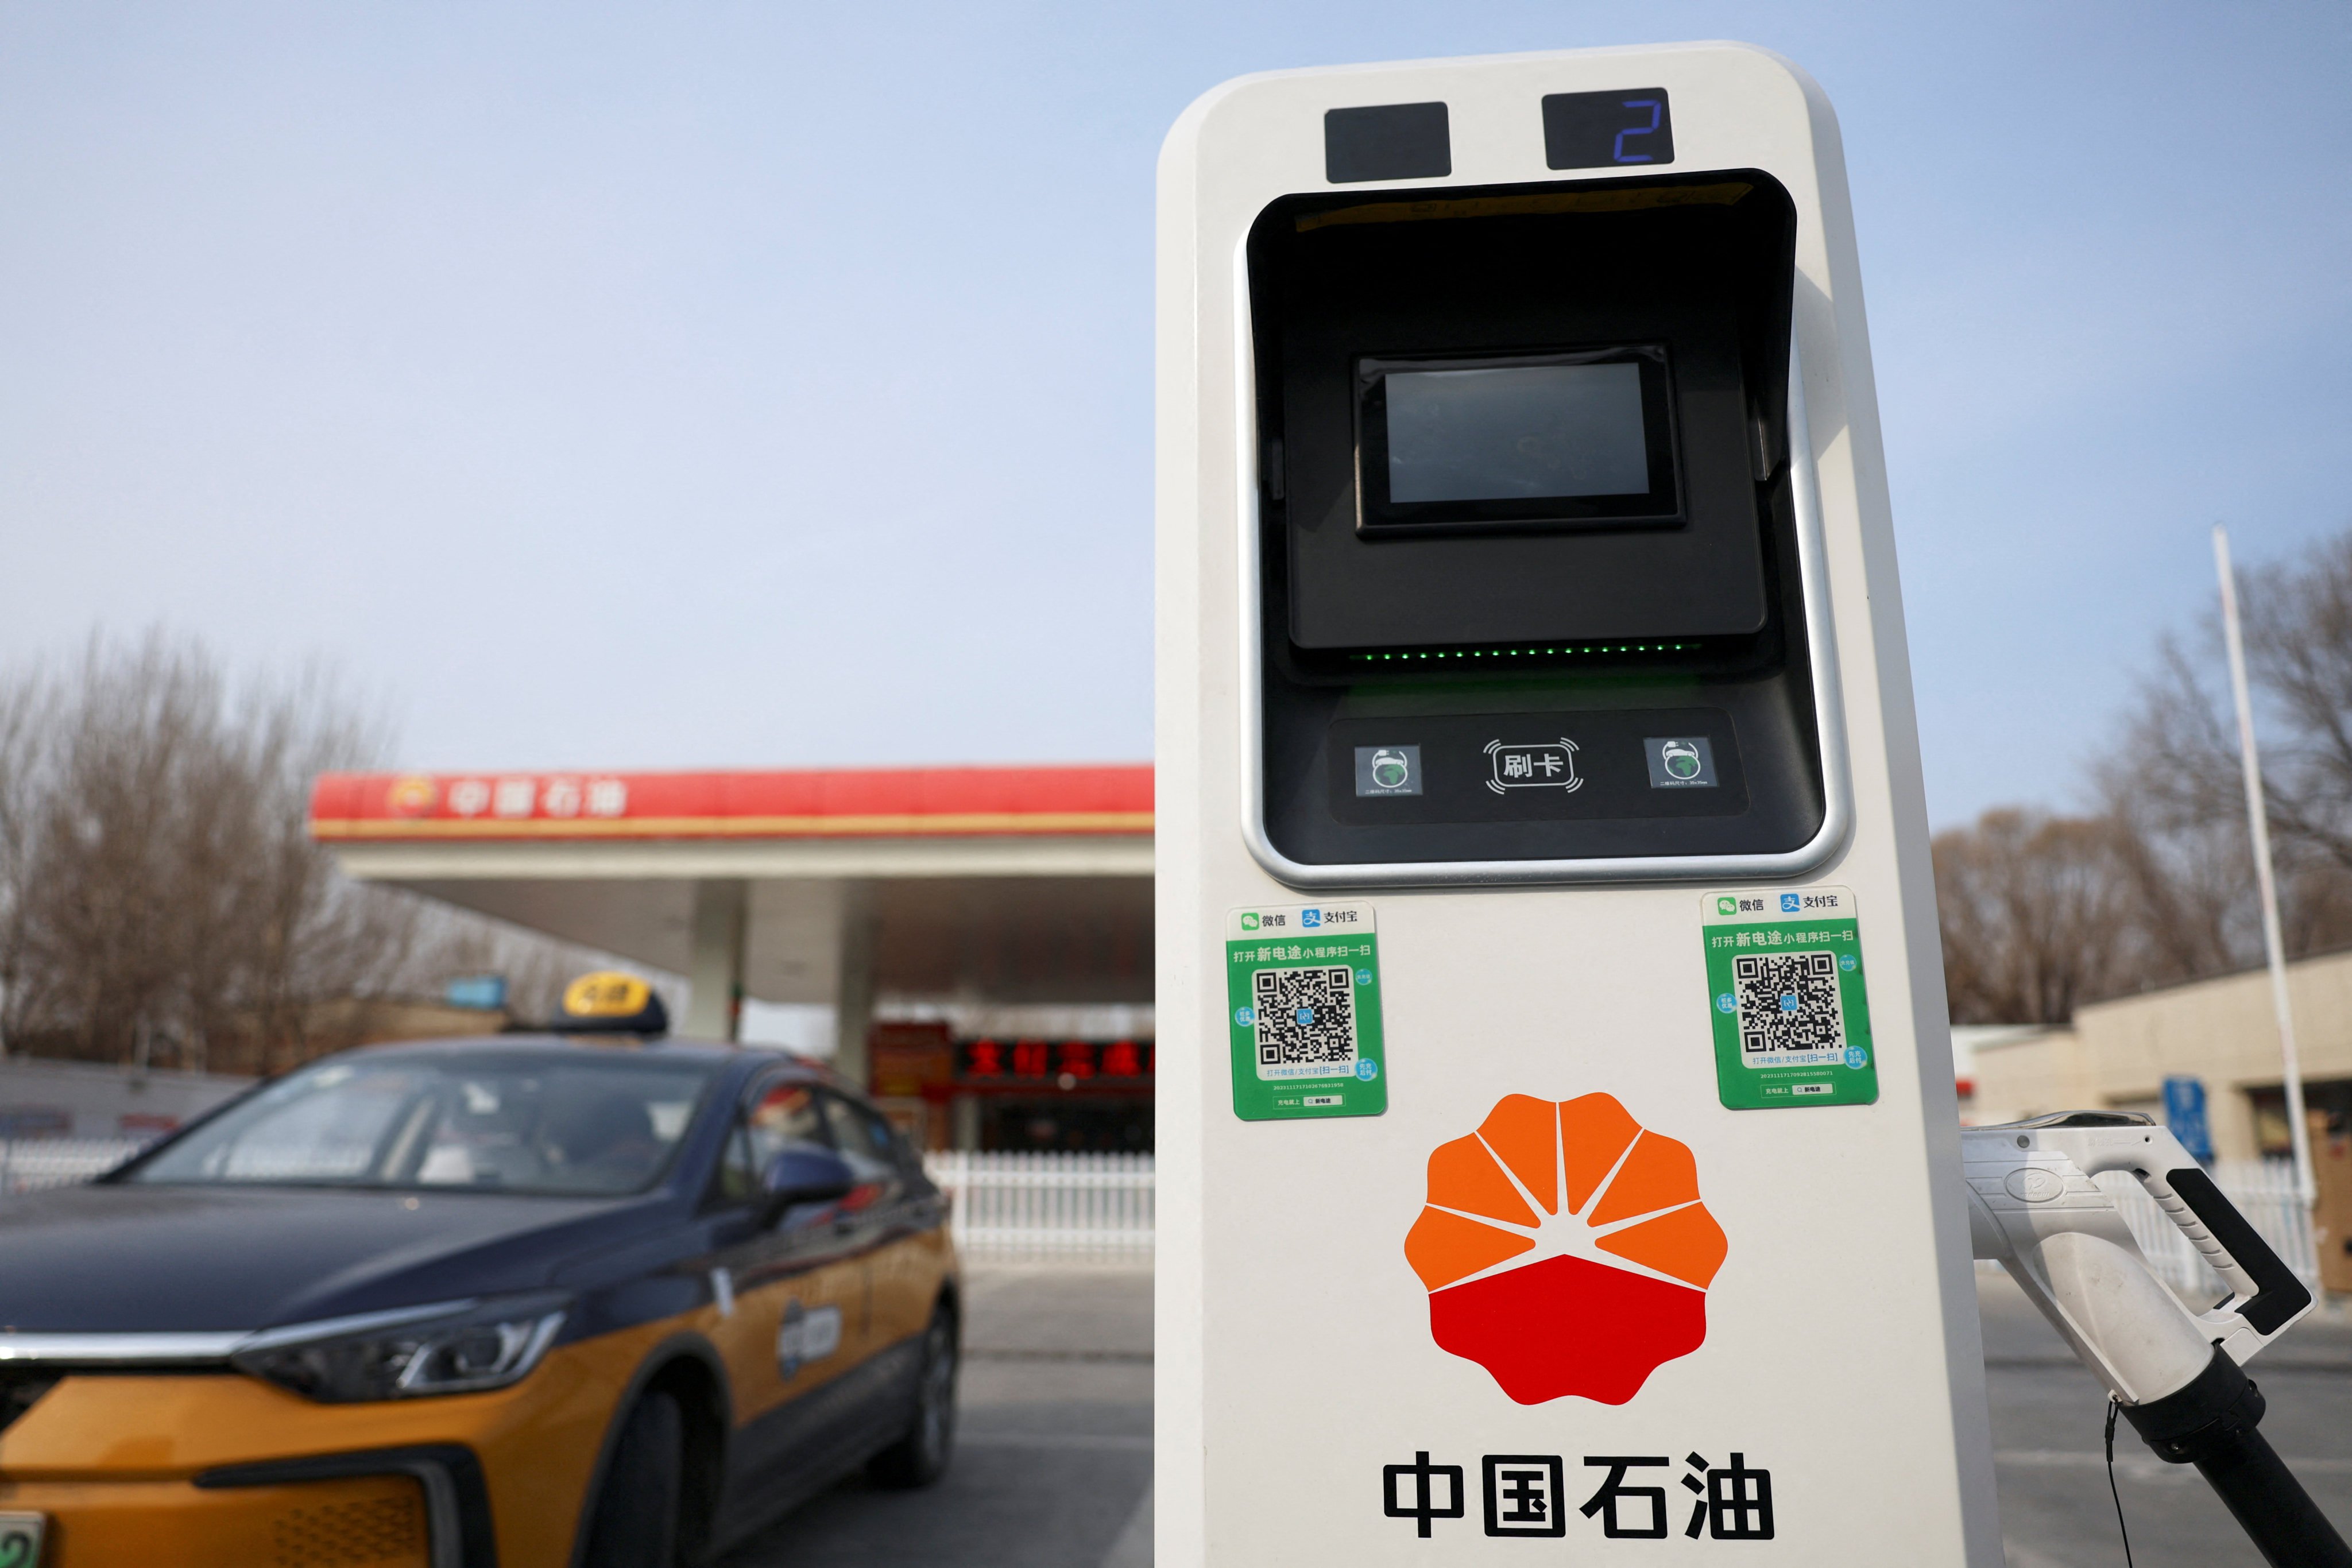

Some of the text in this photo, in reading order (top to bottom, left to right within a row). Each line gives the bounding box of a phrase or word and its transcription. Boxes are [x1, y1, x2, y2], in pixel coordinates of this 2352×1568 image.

[1614, 99, 1662, 162] 2
[1503, 753, 1564, 778] 刷卡
[1739, 899, 1763, 912] 微信
[1803, 895, 1838, 908] 支付宝
[1262, 915, 1286, 927] 微信
[1324, 911, 1357, 924] 支付宝
[1712, 930, 1854, 947] 打开新电途小程序扫一扫
[1233, 945, 1371, 962] 打开新电途小程序扫一扫
[1383, 1451, 1774, 1540] 中国石油
